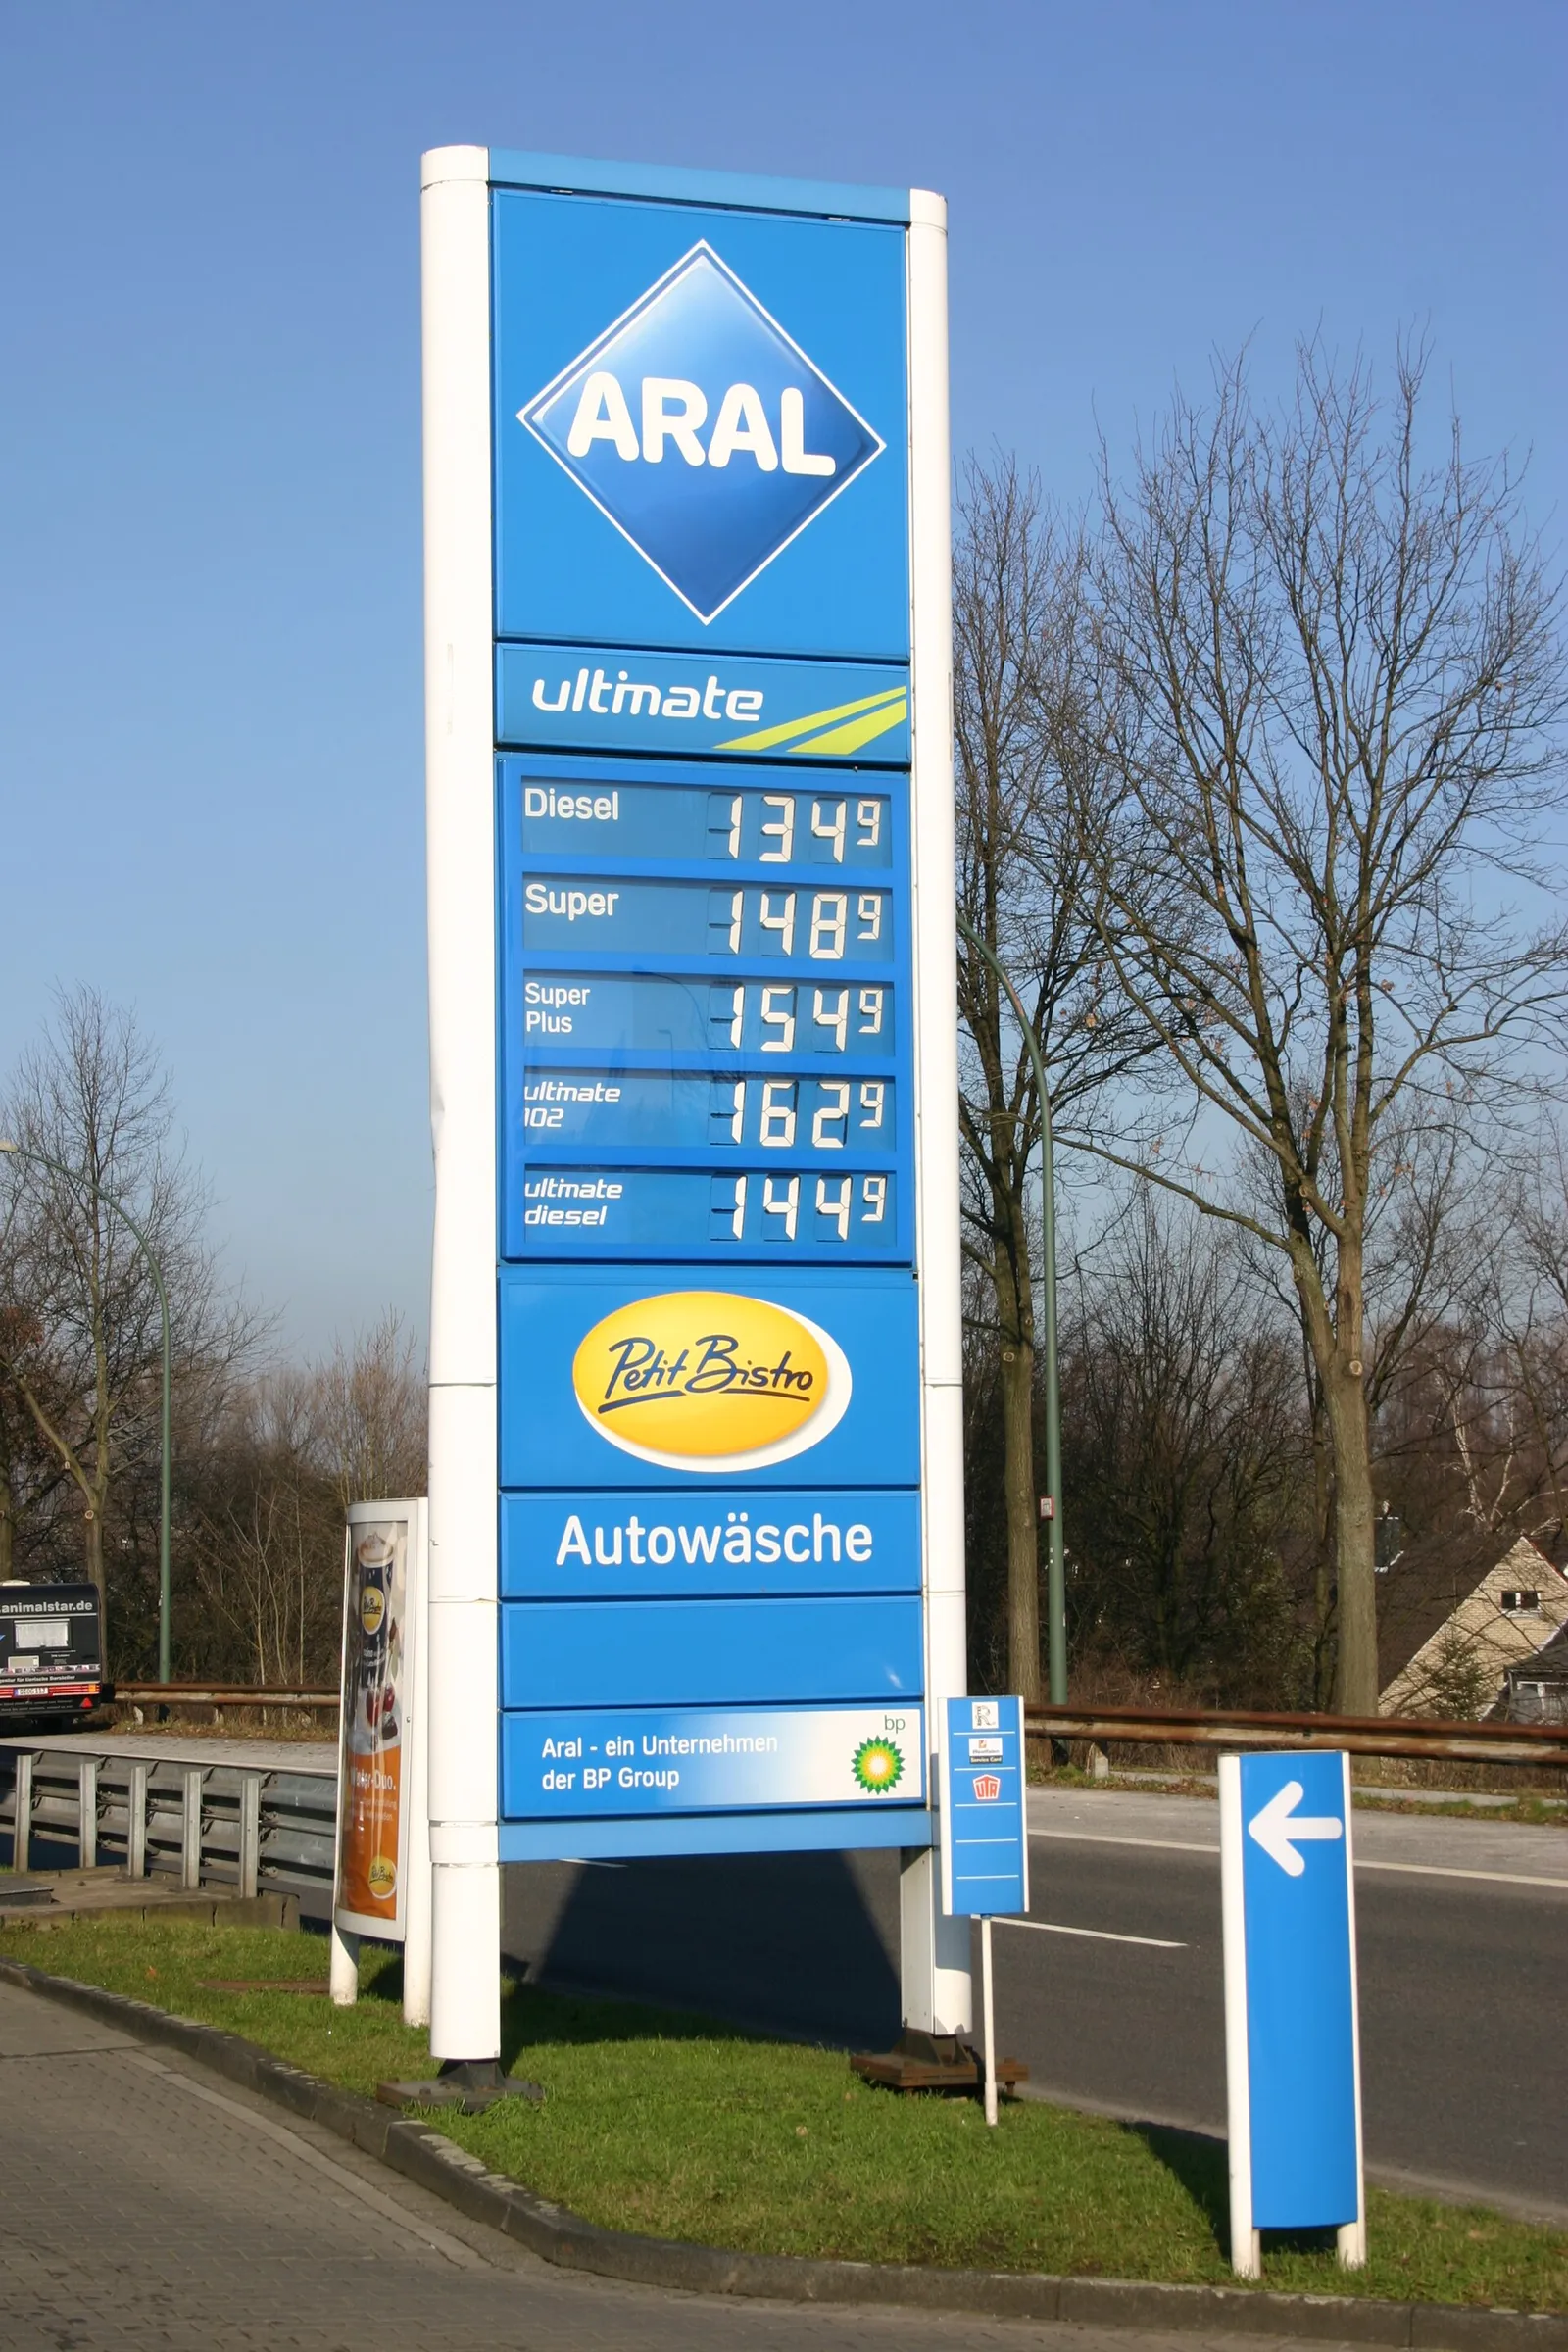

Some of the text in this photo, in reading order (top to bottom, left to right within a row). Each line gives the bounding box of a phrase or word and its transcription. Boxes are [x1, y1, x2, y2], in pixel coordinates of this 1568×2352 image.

[566, 371, 836, 477] ARAL
[531, 668, 764, 722] ultimate
[524, 788, 619, 821] Diesel
[525, 884, 619, 921] Super
[524, 983, 590, 1008] Super
[525, 1010, 573, 1033] Plus
[524, 1082, 621, 1102] ultimate
[524, 1107, 564, 1127] 102
[524, 1178, 623, 1199] ultimate
[524, 1205, 608, 1225] diesel
[605, 1334, 813, 1399] Petit Bistro
[556, 1512, 873, 1566] Autowäsche
[883, 1715, 906, 1735] bp
[542, 1737, 582, 1758] Aral
[605, 1736, 635, 1756] ein
[642, 1734, 779, 1756] Unternehmen
[542, 1767, 680, 1790] der BP Group
[975, 1776, 999, 1797] UTA
